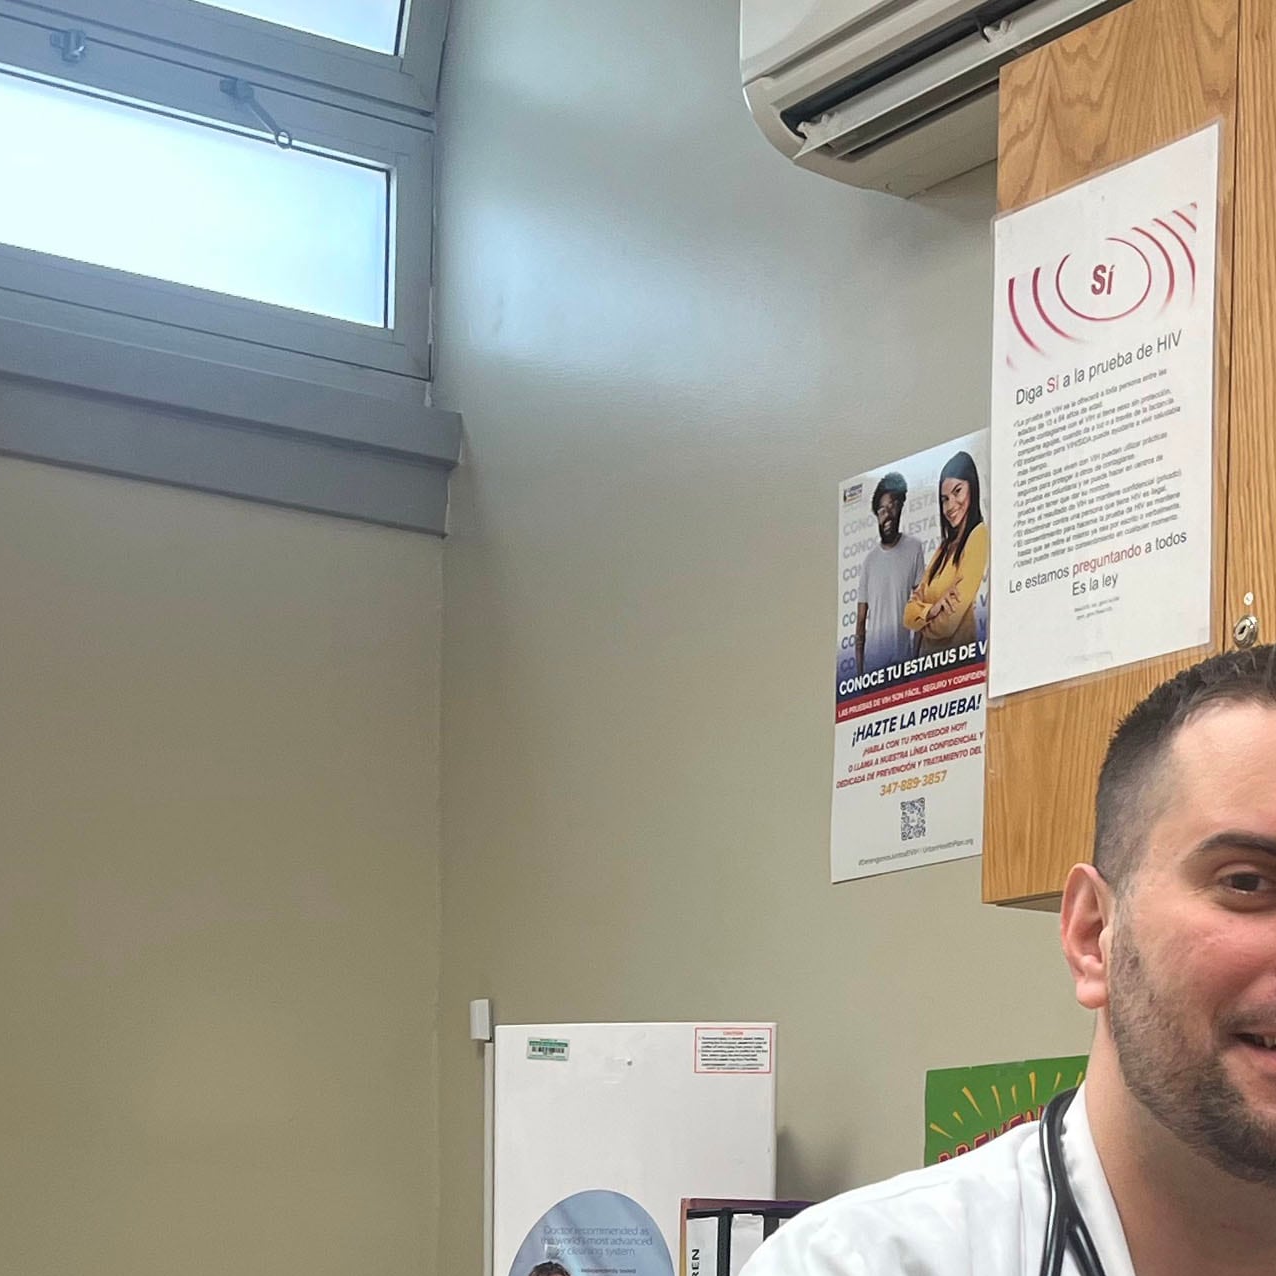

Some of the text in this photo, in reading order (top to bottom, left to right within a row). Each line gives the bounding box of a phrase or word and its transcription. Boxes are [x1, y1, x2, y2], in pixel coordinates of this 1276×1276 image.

[1091, 263, 1116, 296] Sí
[1016, 382, 1044, 405] Diga
[1062, 372, 1070, 388] a
[1074, 367, 1085, 383] la
[1088, 350, 1133, 382] prueba
[1136, 343, 1153, 360] de
[1157, 329, 1182, 353] HIV
[1009, 530, 1187, 594] Le estamos preguntando a todos
[1072, 572, 1118, 596] Es la ley
[839, 640, 988, 695] CONOCE TU ESTATUS DE V
[851, 693, 982, 747] ¡HAZTE LA PRUEBA!
[886, 740, 900, 750] CON
[901, 737, 910, 745] TU
[910, 727, 950, 744] PROVEEDOR
[836, 773, 865, 789] DEDICADA
[867, 771, 874, 781] DE
[876, 761, 916, 778] PREVENCIÓN
[923, 749, 968, 766] TRATAMIENTO
[969, 746, 983, 757] DEL
[854, 759, 873, 772] LLAMA
[880, 751, 908, 765] NUESTRA
[910, 743, 928, 756] LÍNEA
[929, 734, 977, 751] CONFIDENCIAL
[979, 731, 984, 739] Y
[880, 770, 948, 796] 347-889-3857
